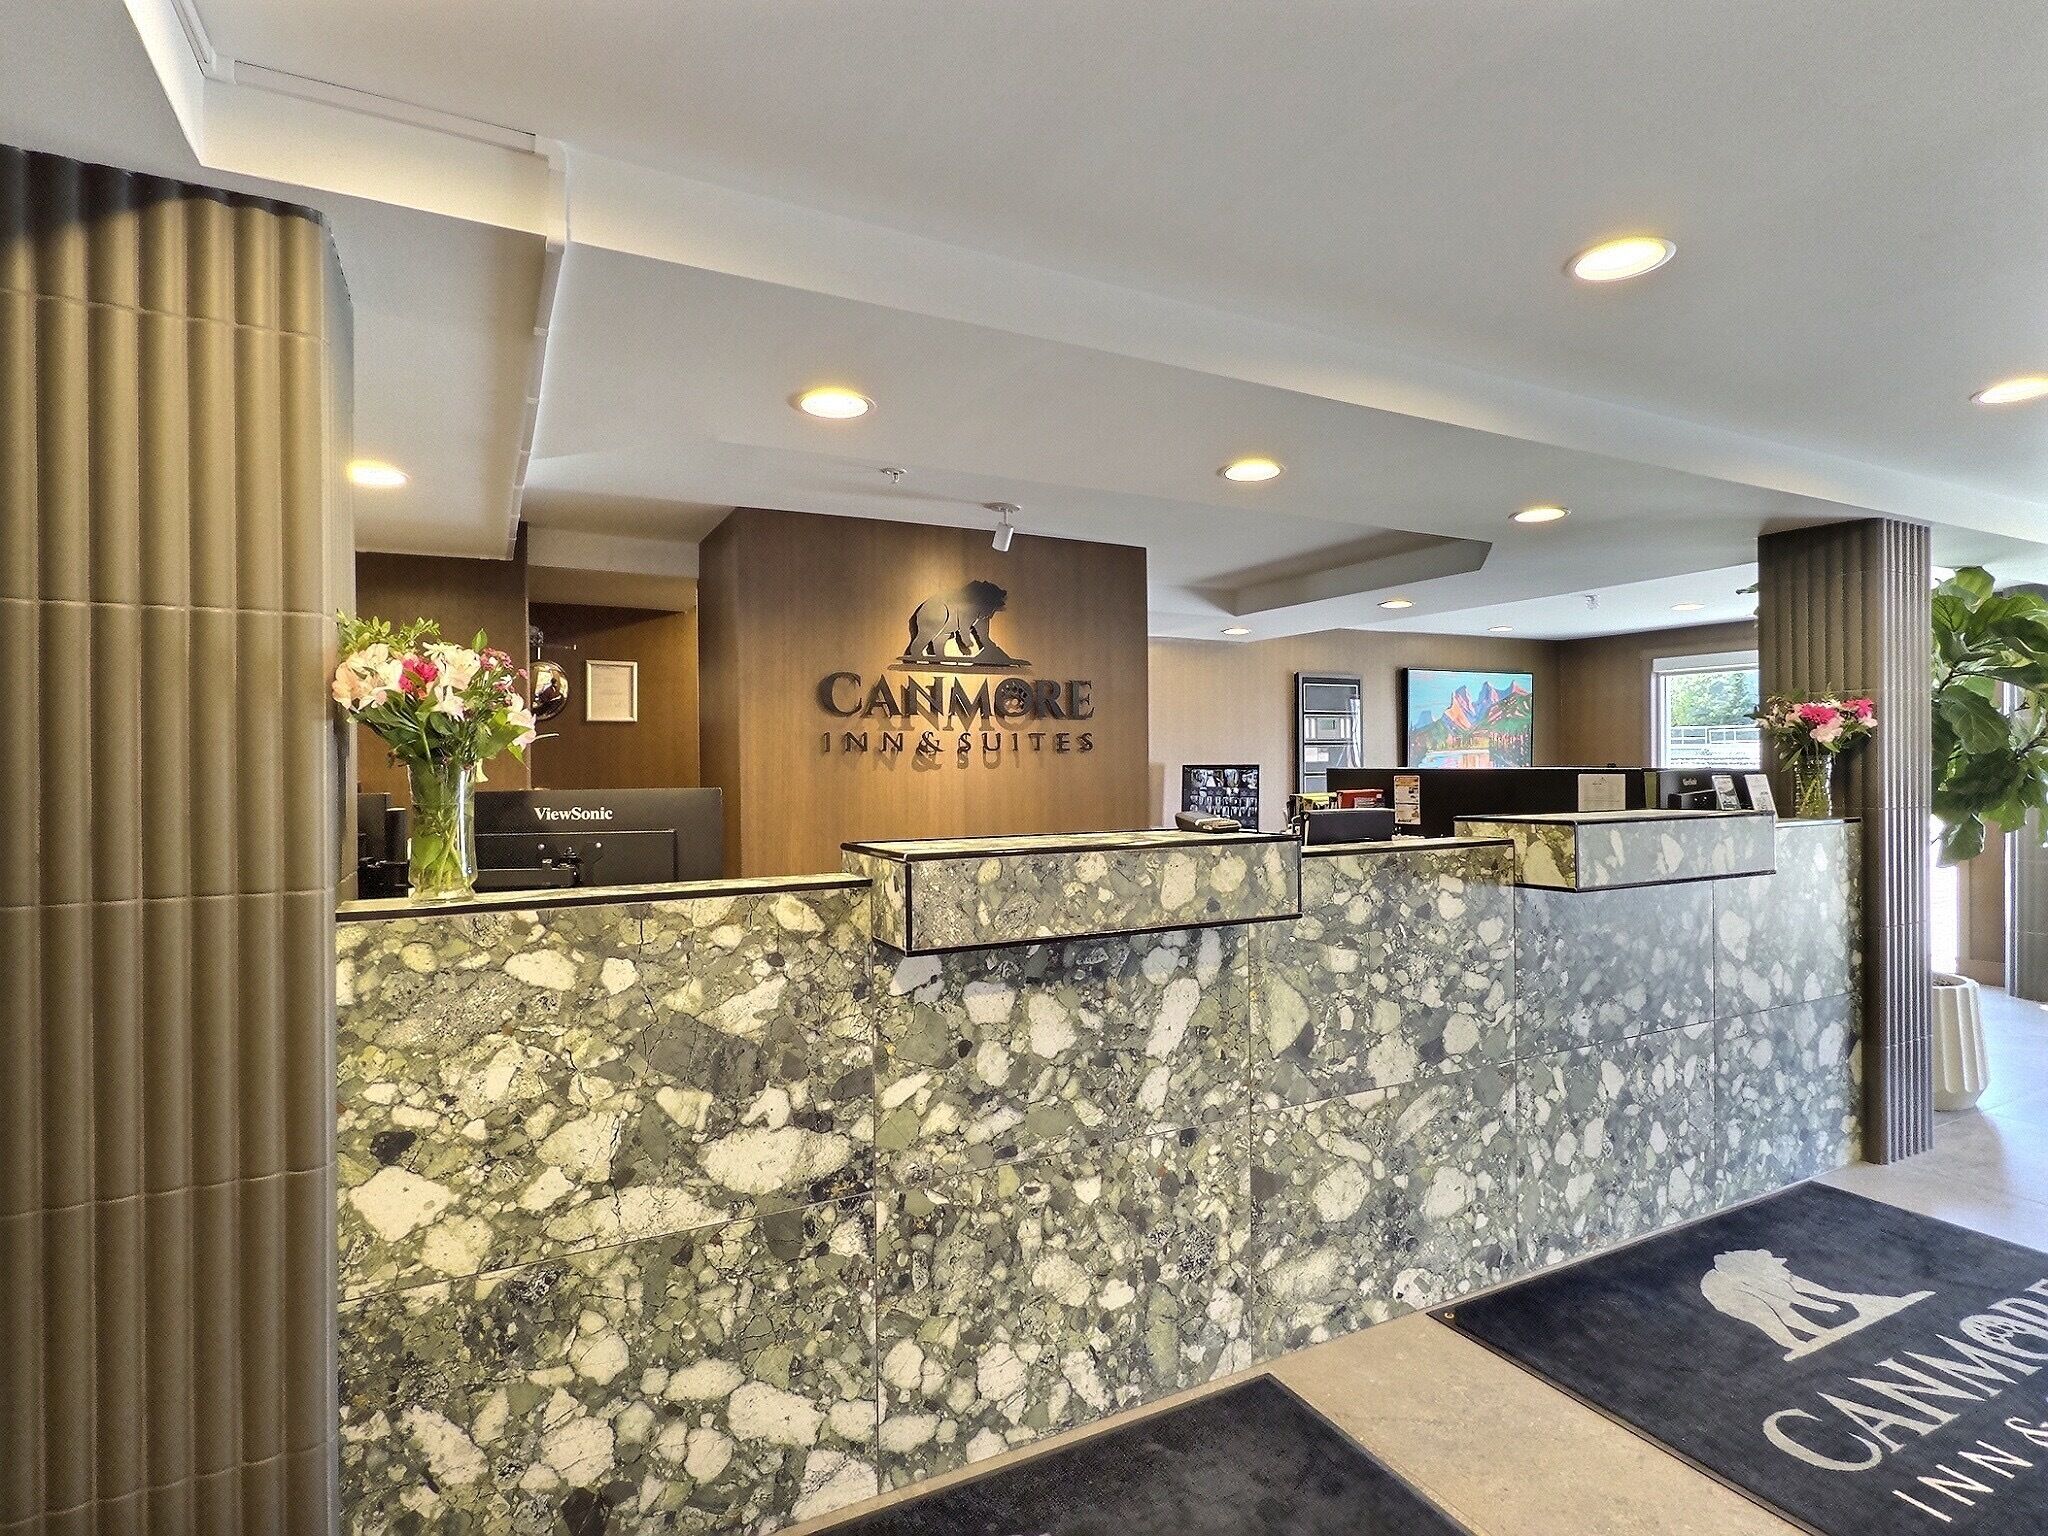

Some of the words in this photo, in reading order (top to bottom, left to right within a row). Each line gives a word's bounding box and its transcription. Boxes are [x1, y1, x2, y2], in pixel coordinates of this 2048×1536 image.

[816, 671, 1095, 720] CANMORE
[822, 731, 903, 753] INN
[916, 731, 945, 757] &
[957, 732, 1094, 753] SUITES
[534, 806, 613, 821] ViewSonic
[1762, 1278, 2048, 1472] CANMO
[1892, 1440, 2034, 1523] INN
